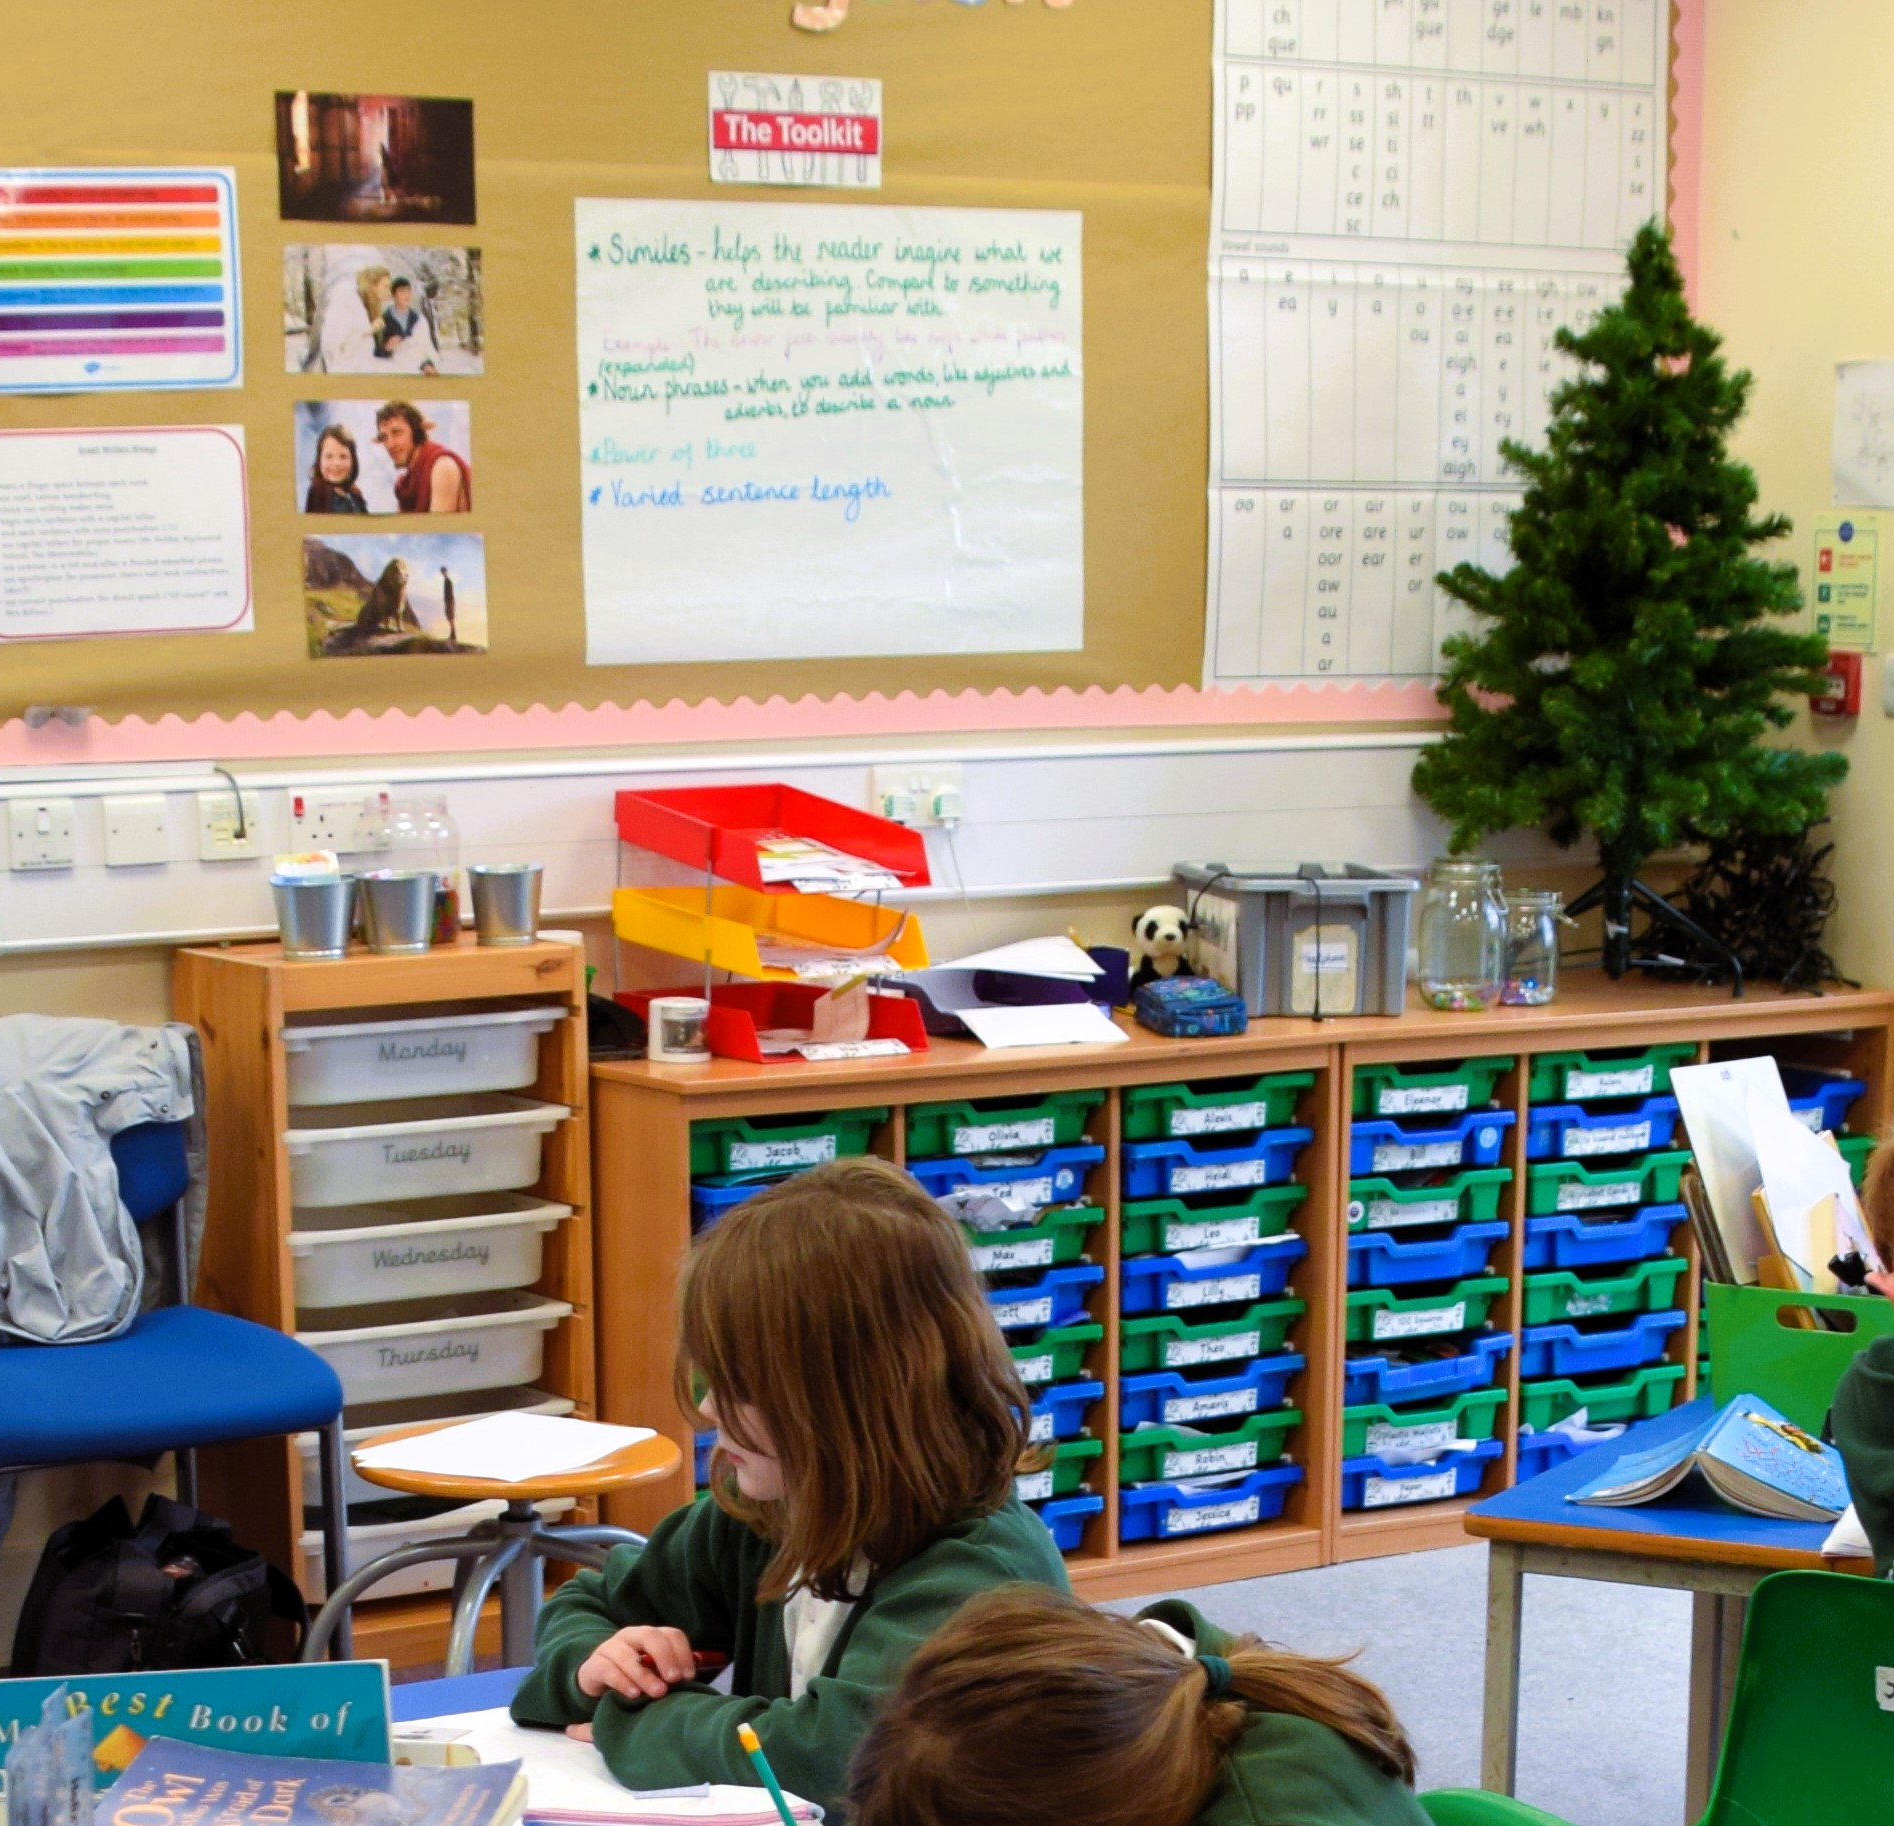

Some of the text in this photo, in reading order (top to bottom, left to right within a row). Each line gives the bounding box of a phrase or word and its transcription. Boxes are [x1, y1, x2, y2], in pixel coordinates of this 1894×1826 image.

[723, 113, 864, 149] The Toolkit
[607, 232, 691, 265] Similes
[713, 225, 762, 274] helps
[774, 232, 803, 263] the
[817, 236, 883, 260] reader
[975, 240, 1027, 262] what
[1039, 248, 1062, 264] we
[705, 276, 737, 292] are
[969, 272, 1061, 310] something
[666, 378, 728, 416] phrases
[800, 372, 829, 402] you
[838, 368, 873, 387] add
[1041, 358, 1072, 378] and
[886, 398, 902, 410] a
[611, 475, 892, 522] Varied sentence length
[378, 1037, 467, 1061] Monday
[1405, 1094, 1441, 1105] Eleanor
[1205, 1113, 1233, 1124] Alexis
[988, 1128, 1019, 1141] Olivia
[382, 1141, 471, 1164] Tuesday
[766, 1144, 800, 1158] Jacob
[1205, 1170, 1232, 1181] Heidi
[991, 1185, 1012, 1198] Ted
[373, 1241, 490, 1269] Wednesday
[993, 1249, 1015, 1261] Max
[377, 1340, 480, 1368] Thursday
[1200, 1343, 1225, 1353] Theo
[1195, 1454, 1226, 1465] Robin
[1196, 1509, 1231, 1521] Jessica
[66, 1690, 174, 1719] Best
[189, 1704, 288, 1733] Book
[310, 1701, 353, 1736] of
[250, 1778, 308, 1823] Dark
